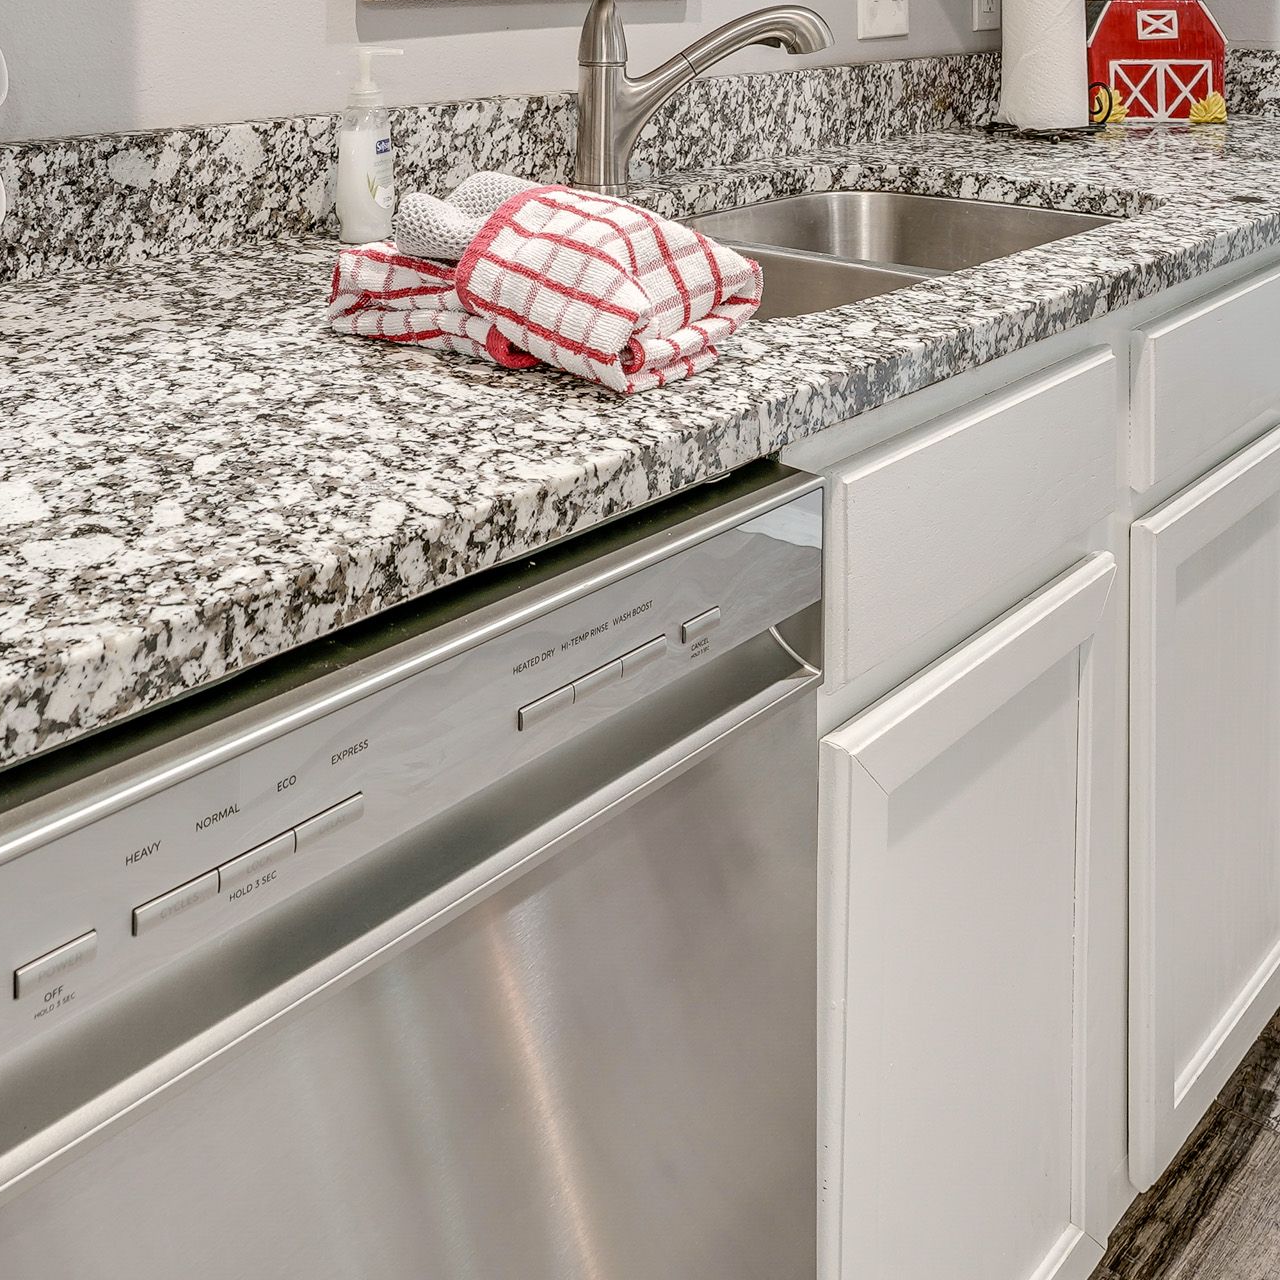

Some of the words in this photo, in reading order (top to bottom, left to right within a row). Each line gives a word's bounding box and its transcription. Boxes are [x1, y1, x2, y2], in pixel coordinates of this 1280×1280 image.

[612, 610, 631, 626] WASH
[632, 600, 654, 617] BOOST
[590, 621, 609, 638] RINSE
[512, 656, 540, 675] HEATED
[541, 647, 556, 662] DRY
[331, 739, 369, 765] EXPRESS
[277, 774, 297, 792] ECO
[195, 803, 240, 832] NORMAL
[125, 840, 161, 866] HEAVY
[229, 883, 253, 902] HOLD
[255, 879, 260, 889] 3
[261, 870, 277, 887] SEC
[34, 1004, 55, 1020] HOLD
[62, 992, 75, 1005] SEC
[44, 984, 64, 1002] OFF
